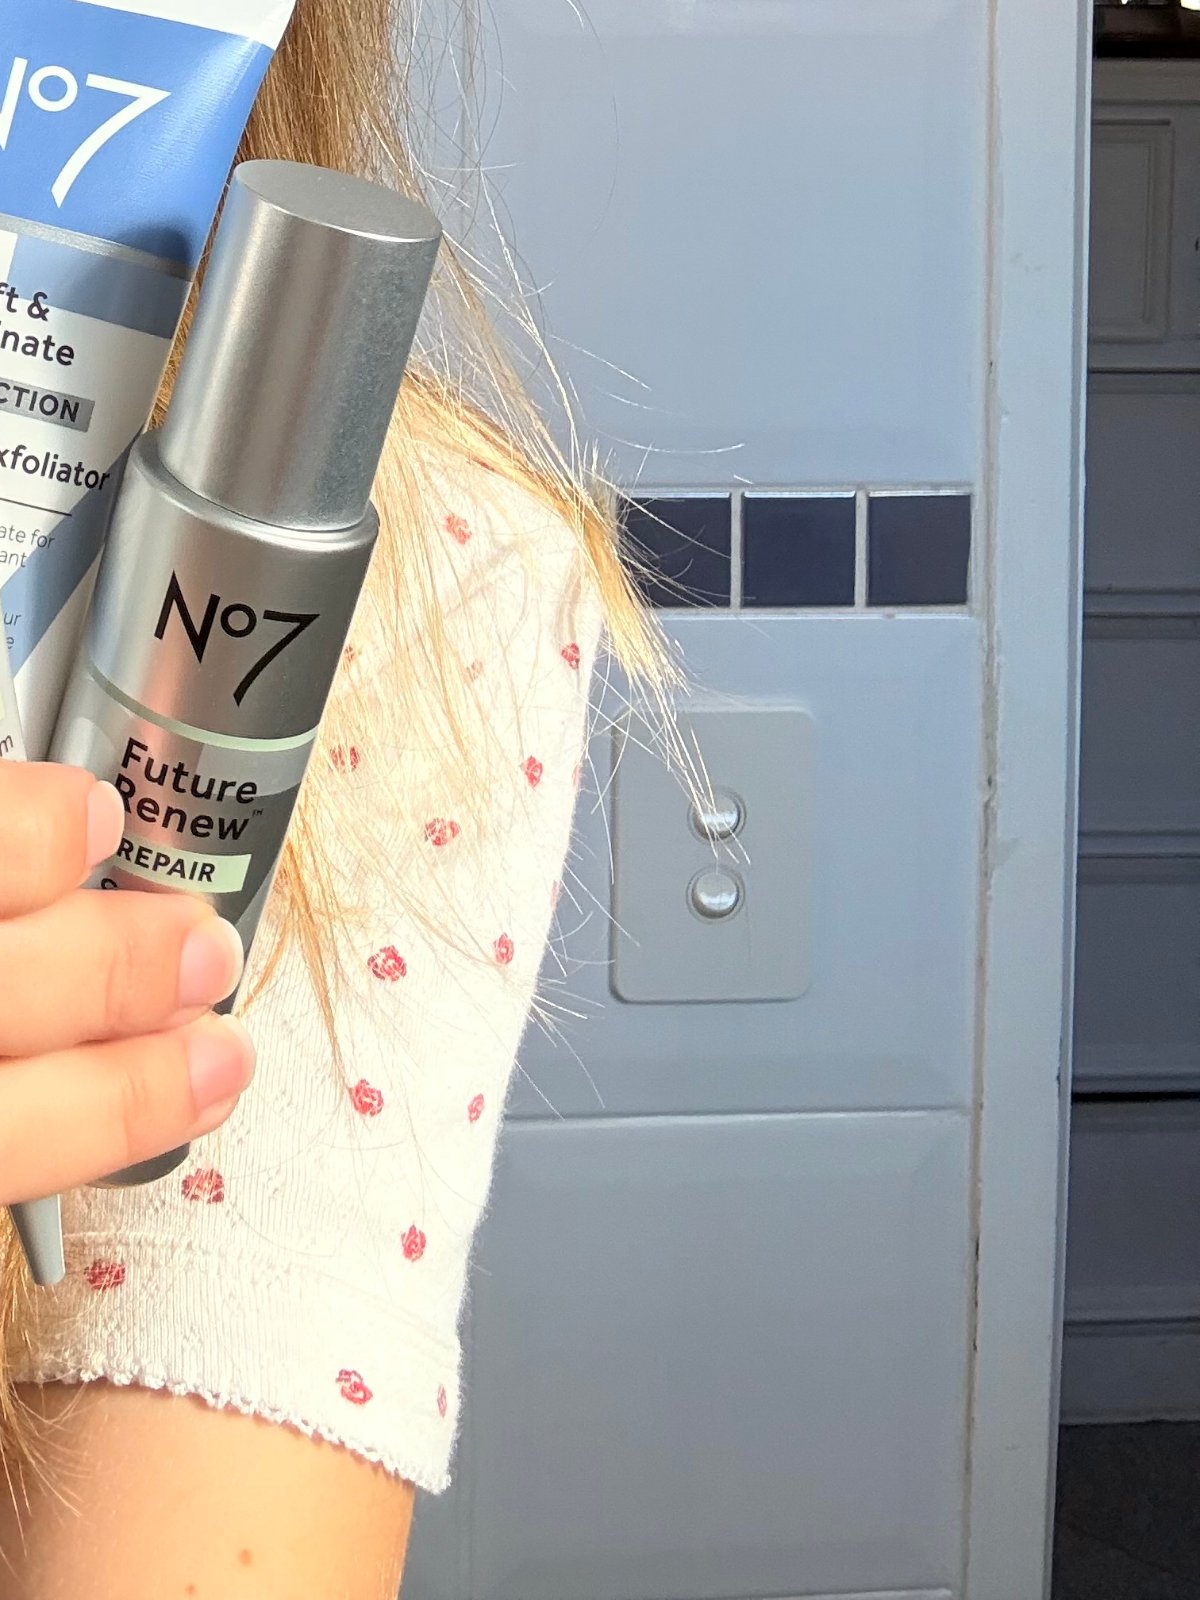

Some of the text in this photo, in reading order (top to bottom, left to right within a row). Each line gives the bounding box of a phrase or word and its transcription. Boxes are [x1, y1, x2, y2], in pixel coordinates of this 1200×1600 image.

[26, 291, 50, 321] &
[30, 529, 55, 549] for
[120, 736, 258, 804] Future
[114, 772, 250, 841] Renew
[116, 837, 217, 883] REPAIR
